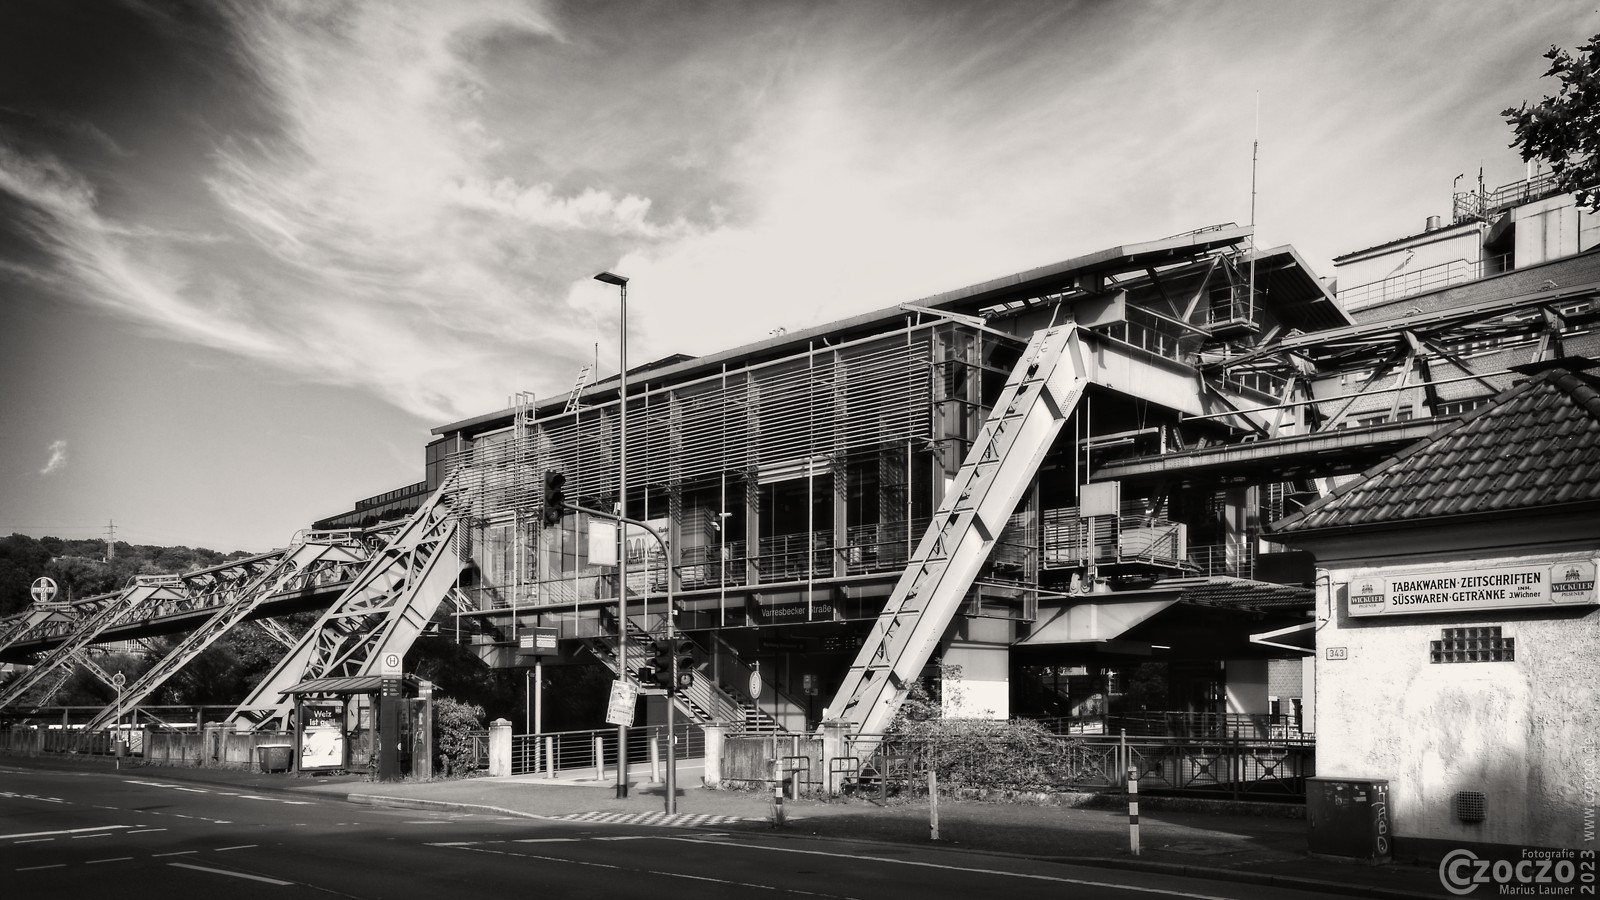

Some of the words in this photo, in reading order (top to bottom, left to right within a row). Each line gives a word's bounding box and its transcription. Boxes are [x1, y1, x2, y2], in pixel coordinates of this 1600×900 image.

[761, 607, 806, 617] Varresbecker
[808, 604, 832, 614] traße
[1329, 649, 1344, 657] 343
